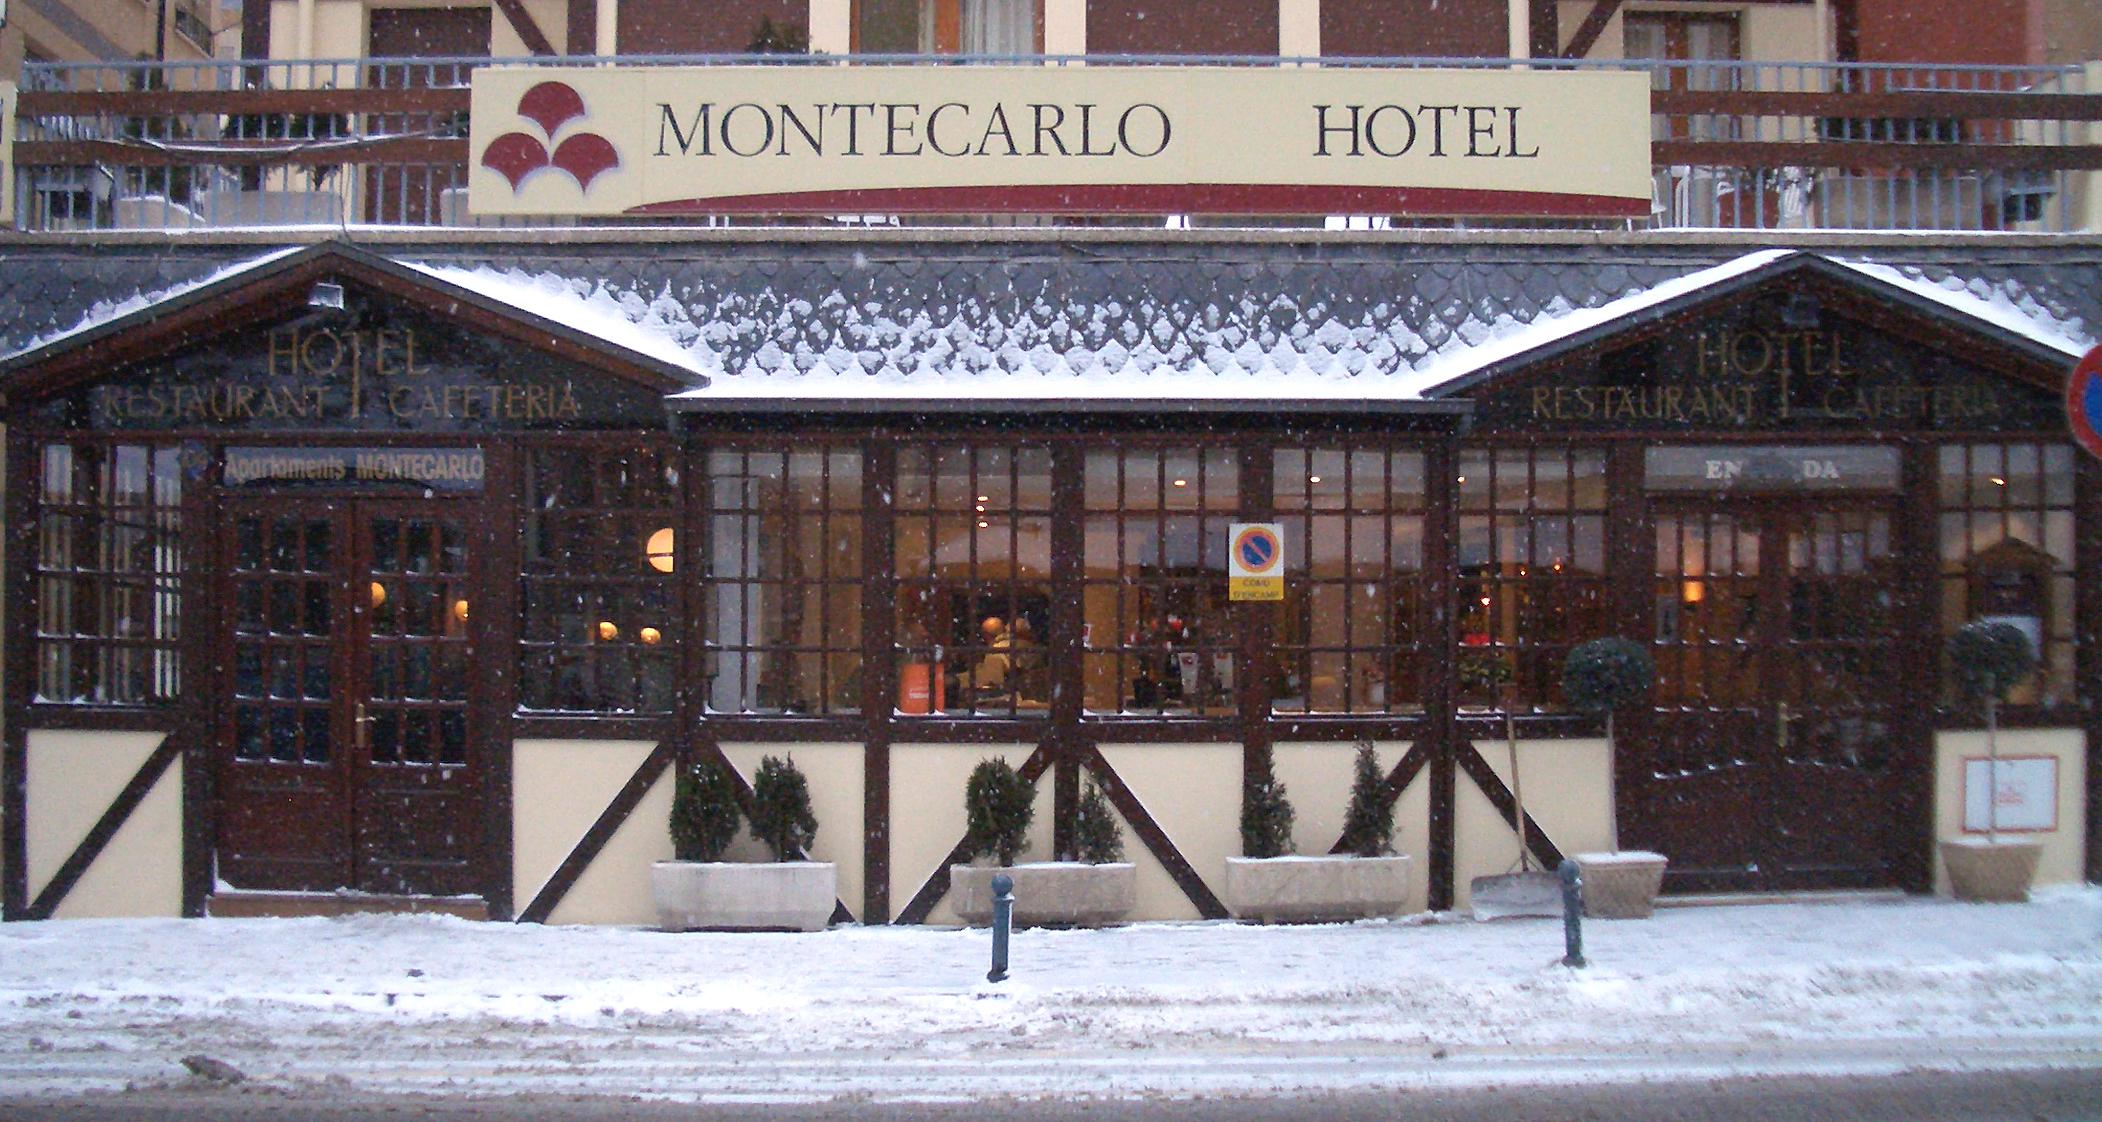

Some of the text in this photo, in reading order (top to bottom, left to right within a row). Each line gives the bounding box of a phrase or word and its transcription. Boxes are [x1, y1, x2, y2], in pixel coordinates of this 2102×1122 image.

[653, 102, 1540, 157] MONTECARLO HOTEL
[268, 328, 430, 419] HOTEL
[1699, 329, 1857, 418] HOTEL
[104, 384, 580, 420] RESTAURANT CAFETERIA
[1531, 385, 1999, 420] RESTAURANT CAFETERIA
[225, 451, 486, 483] Apartaments MONTECARLO
